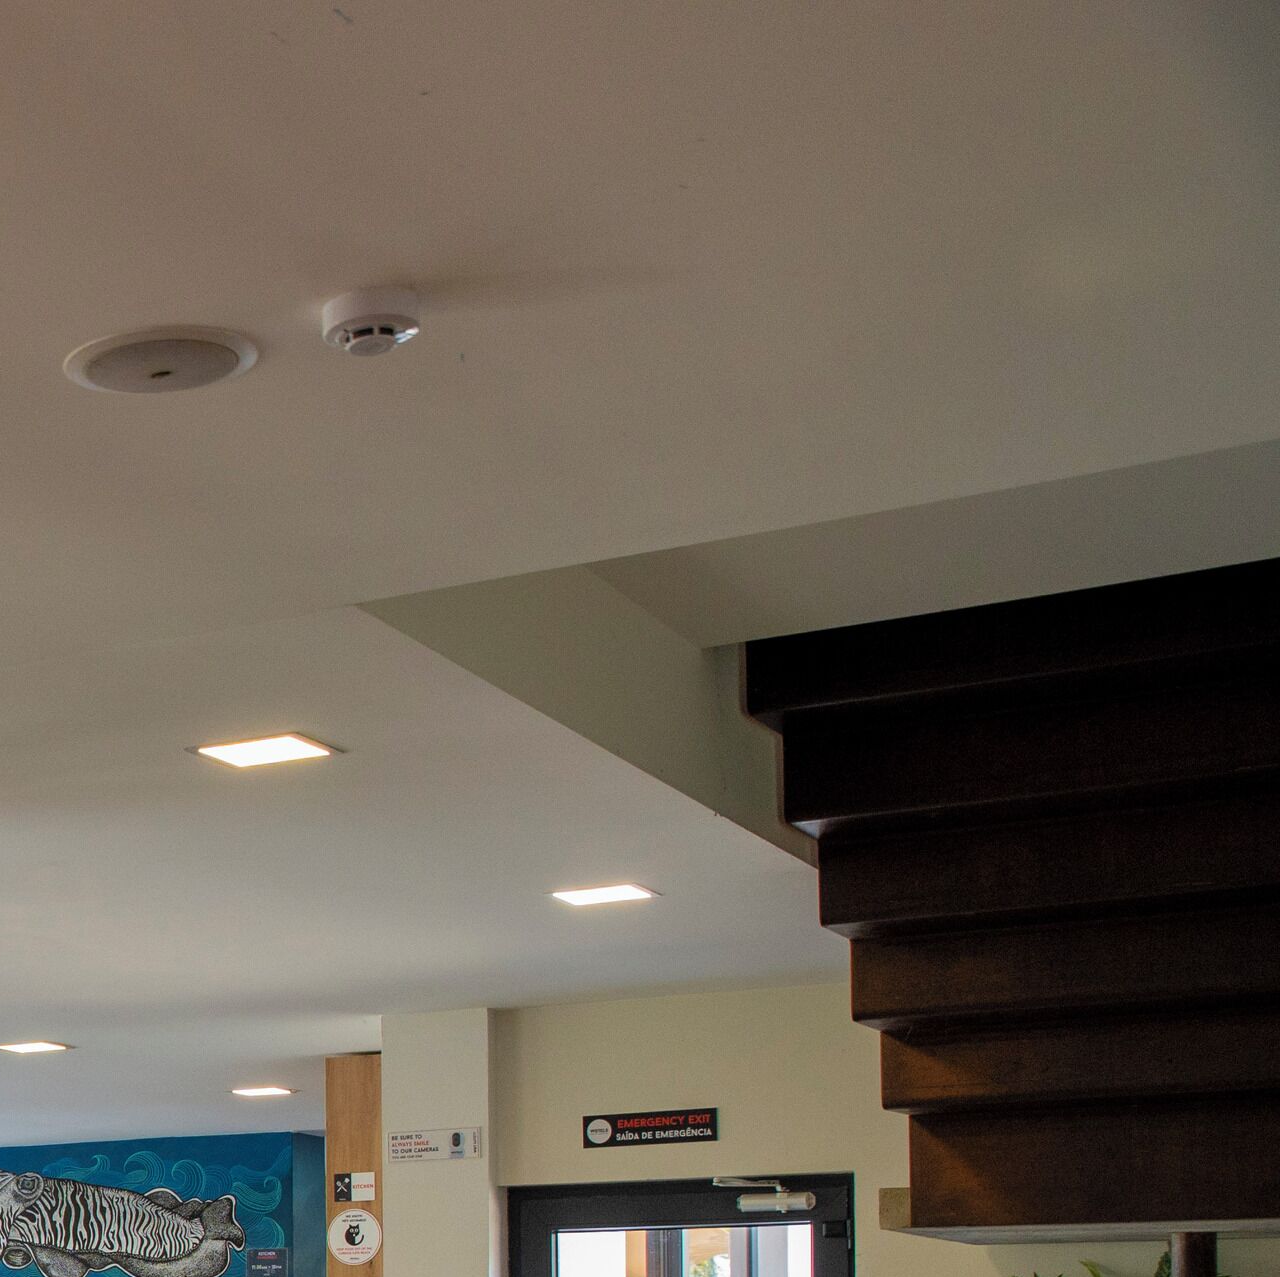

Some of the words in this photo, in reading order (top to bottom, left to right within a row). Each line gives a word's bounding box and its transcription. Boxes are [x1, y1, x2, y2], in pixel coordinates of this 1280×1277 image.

[617, 1116, 685, 1129] EMERGENCY
[688, 1114, 711, 1124] EXIT
[616, 1130, 639, 1141] SAÍDA
[642, 1131, 653, 1139] DE
[655, 1127, 712, 1139] EMERGÊNCIA
